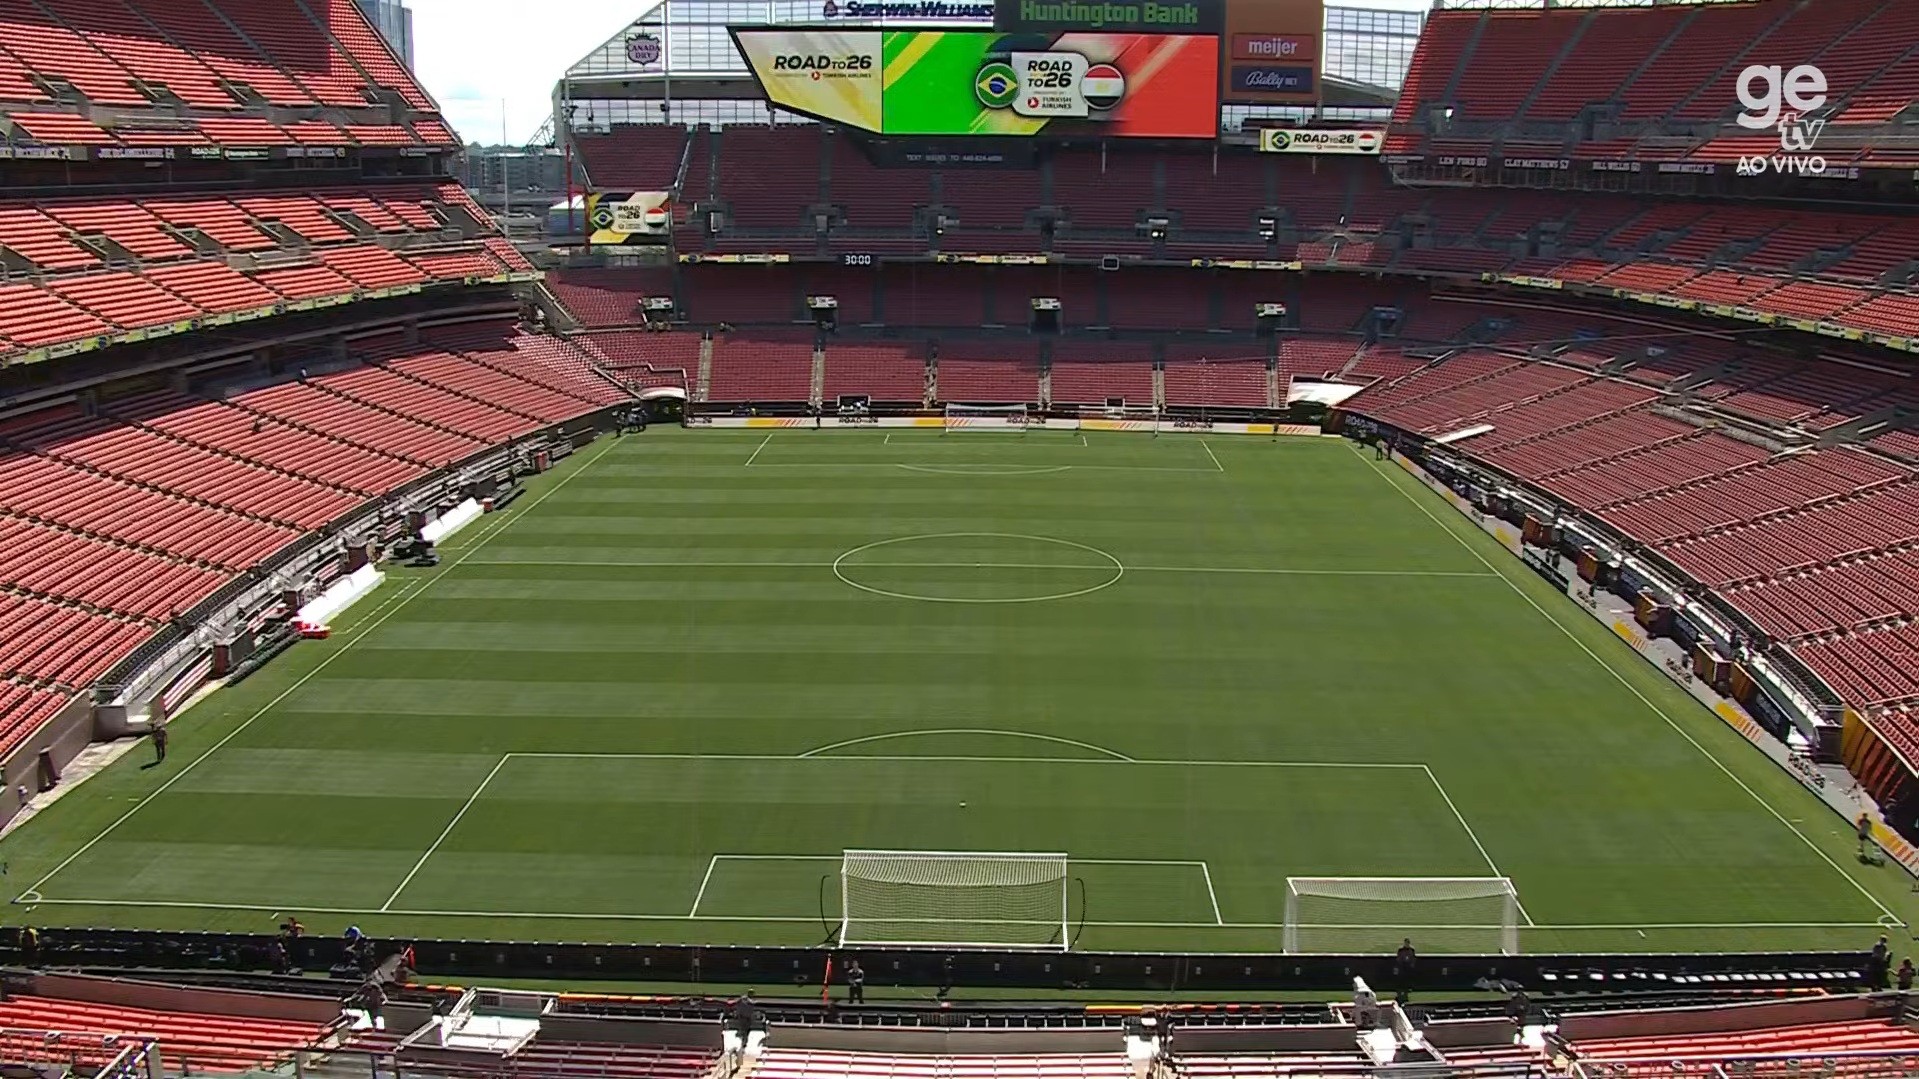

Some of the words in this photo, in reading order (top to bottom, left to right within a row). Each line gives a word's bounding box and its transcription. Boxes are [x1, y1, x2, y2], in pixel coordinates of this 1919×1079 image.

[1020, 0, 1138, 27] Huntington
[1144, 2, 1198, 23] Bank
[1248, 38, 1298, 57] meijer
[1028, 60, 1073, 71] ROAD
[1245, 71, 1284, 88] Bally
